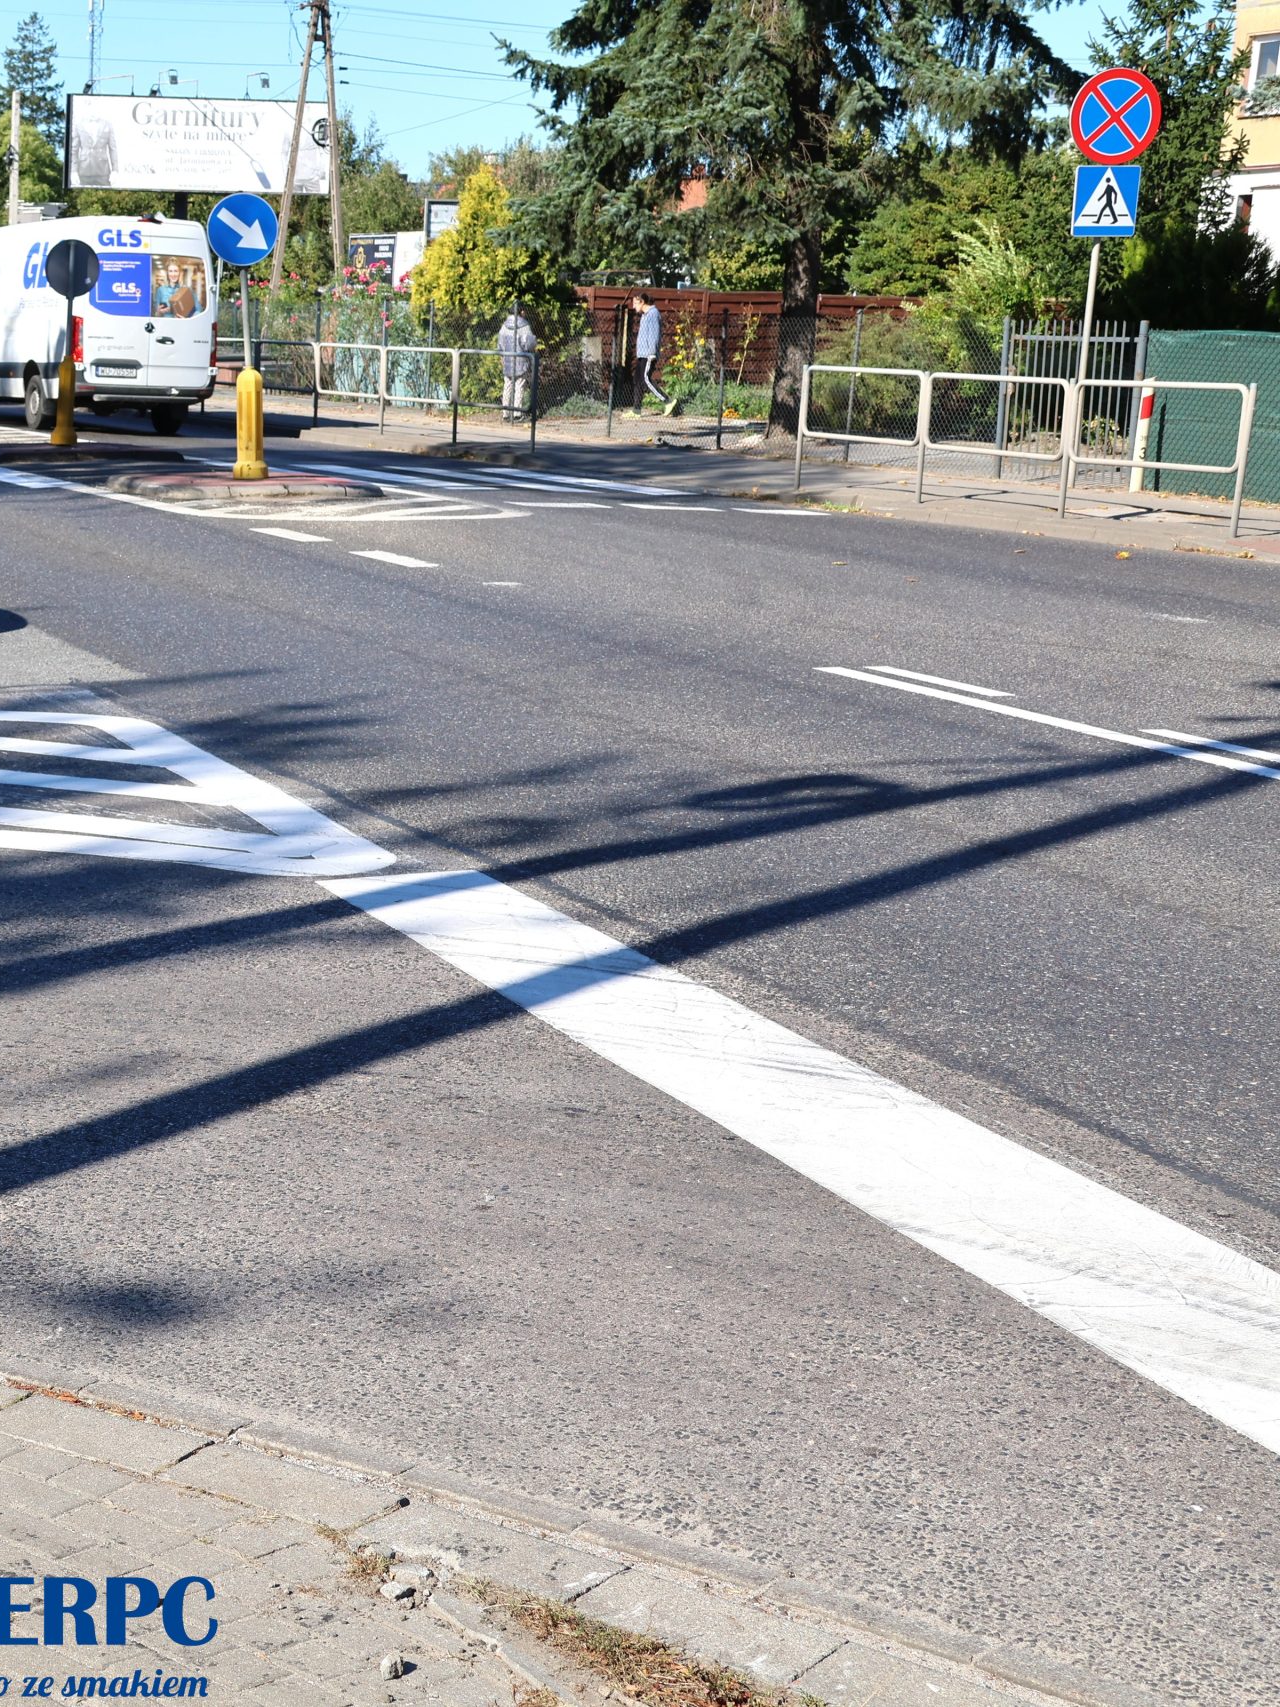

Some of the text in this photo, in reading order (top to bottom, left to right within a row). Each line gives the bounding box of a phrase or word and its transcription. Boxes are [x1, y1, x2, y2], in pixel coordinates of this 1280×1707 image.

[132, 101, 266, 135] Garnitury
[142, 130, 178, 143] szyte
[184, 131, 199, 140] na
[112, 282, 136, 293] GLS
